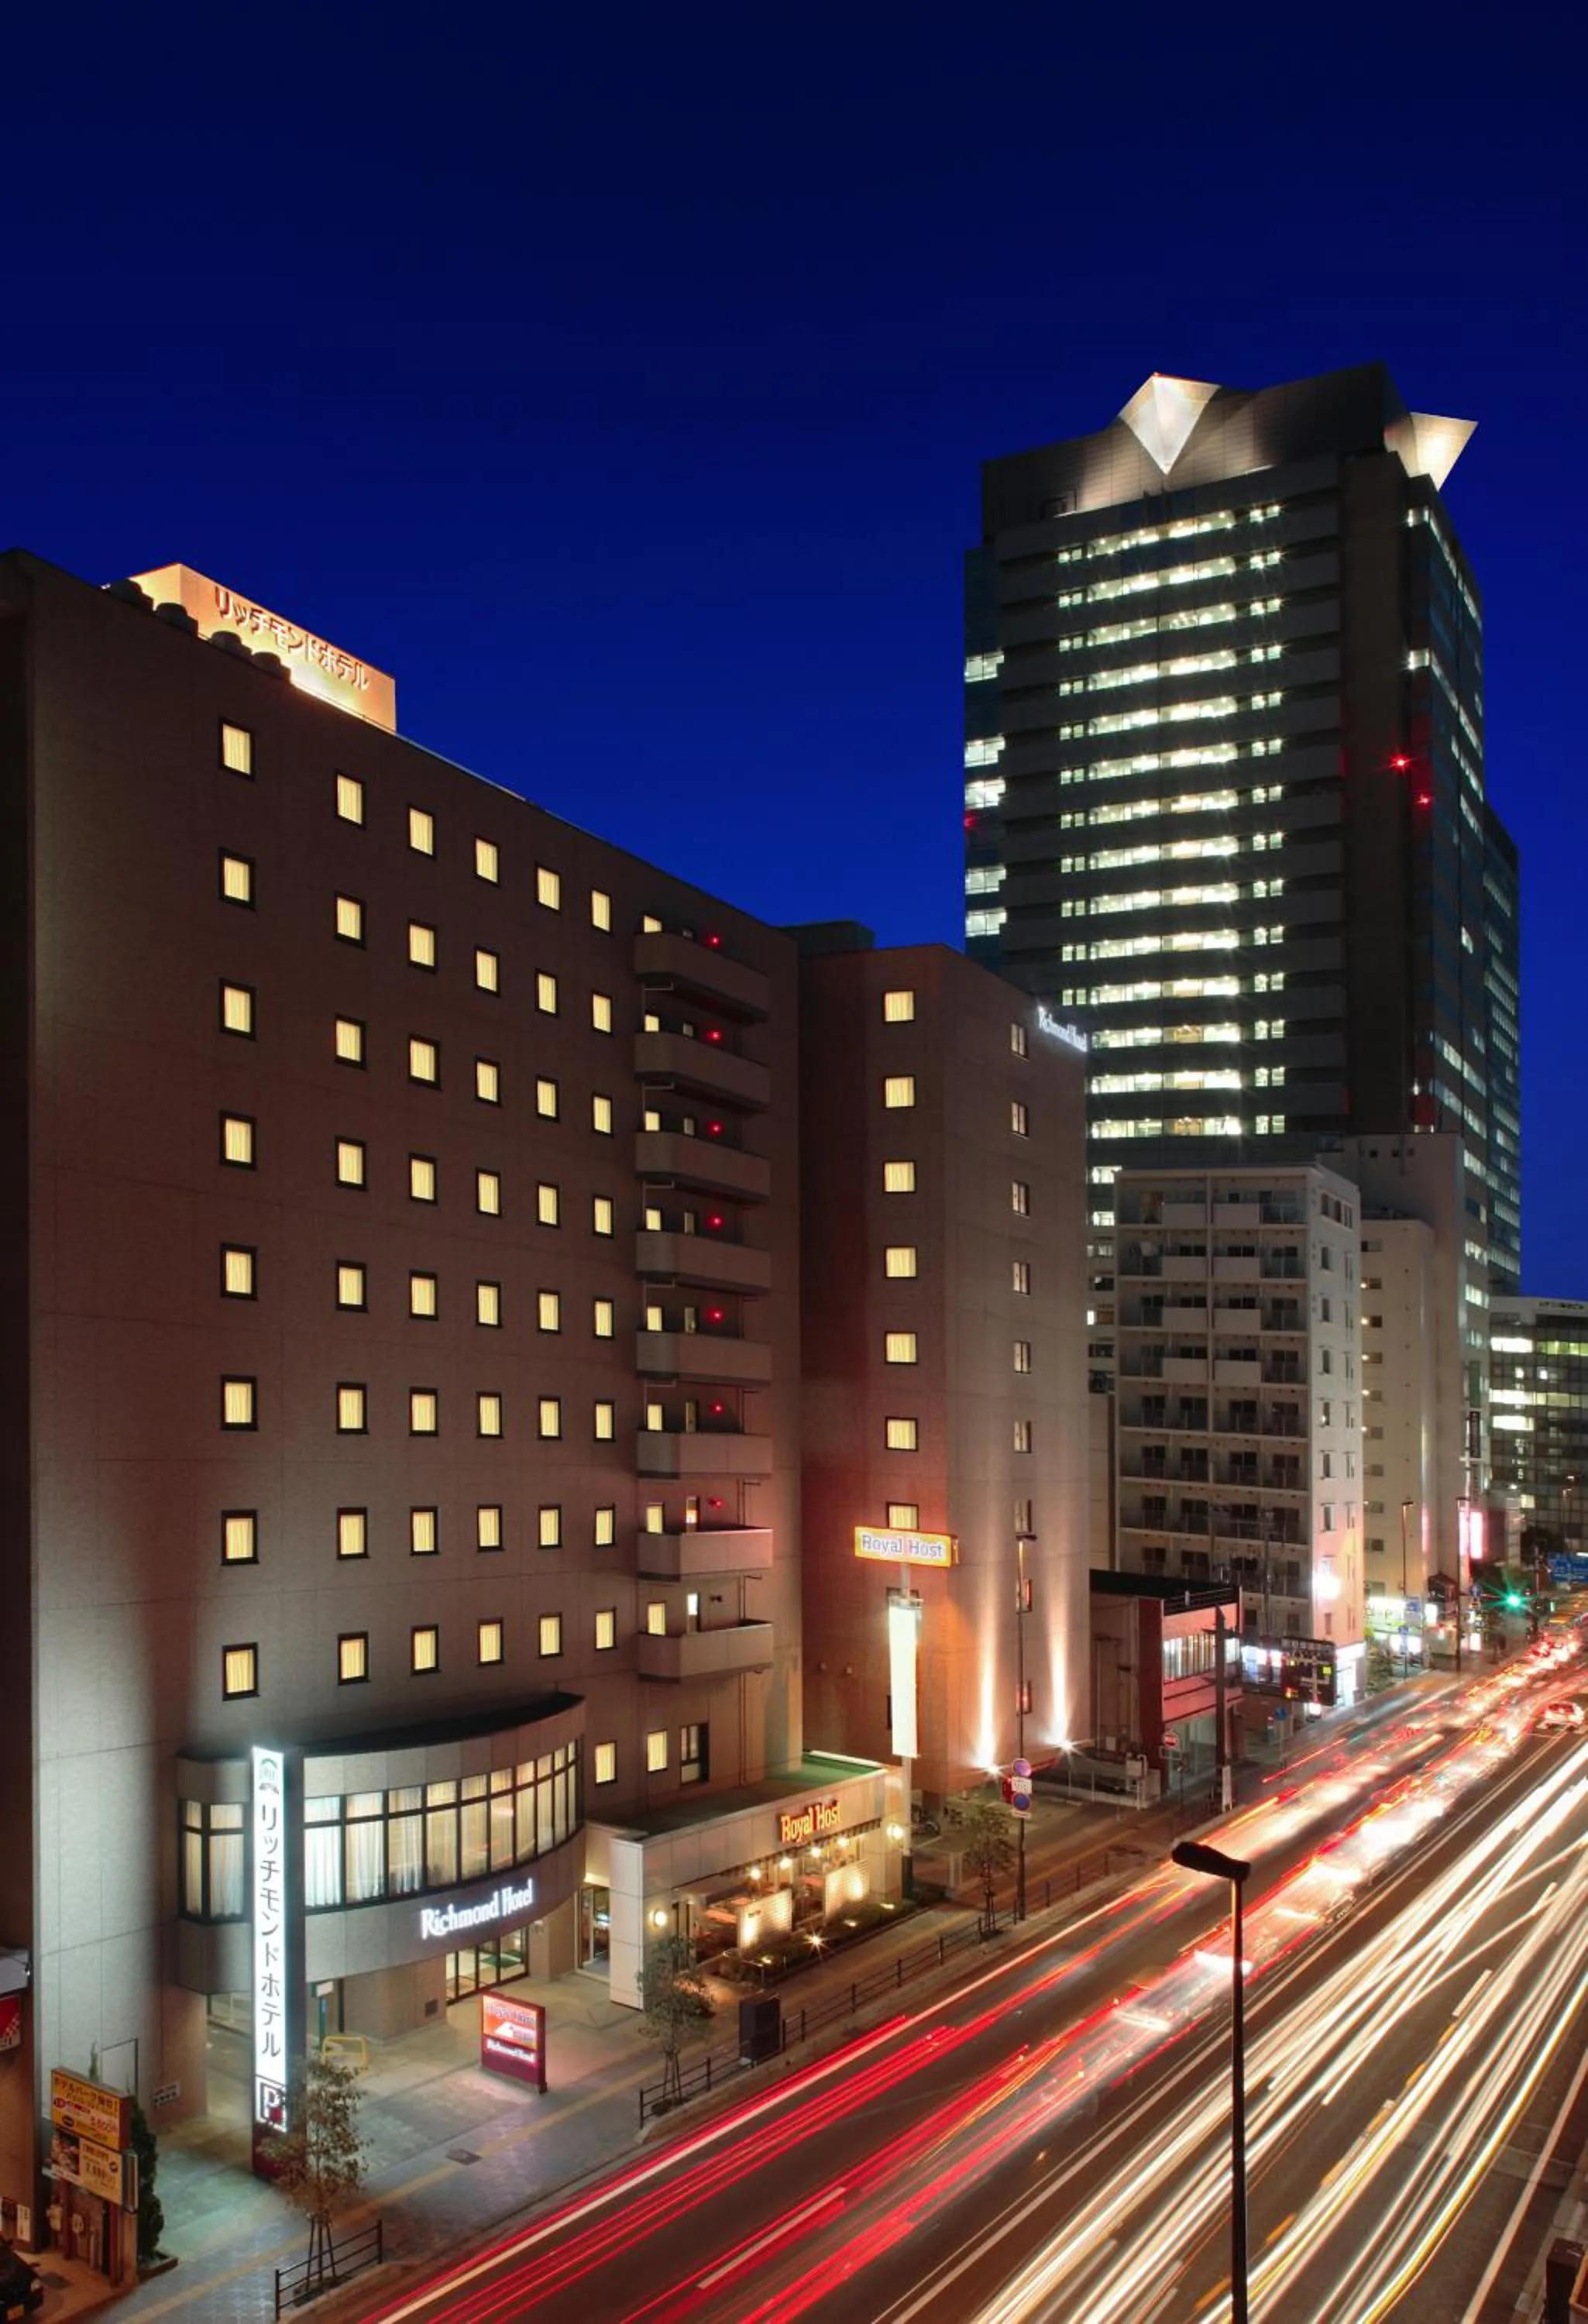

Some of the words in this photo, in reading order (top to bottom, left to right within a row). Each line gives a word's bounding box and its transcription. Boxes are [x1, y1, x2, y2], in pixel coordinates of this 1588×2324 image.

[215, 586, 370, 690] リッチモンドホテル
[861, 1534, 902, 1553] Royal
[909, 1538, 943, 1558] Host
[779, 1806, 814, 1844] Royal
[815, 1802, 840, 1831] Host
[260, 1804, 281, 2058] リッチモンドホテル
[421, 1890, 500, 1941] Richmond
[502, 1877, 533, 1917] Hotel
